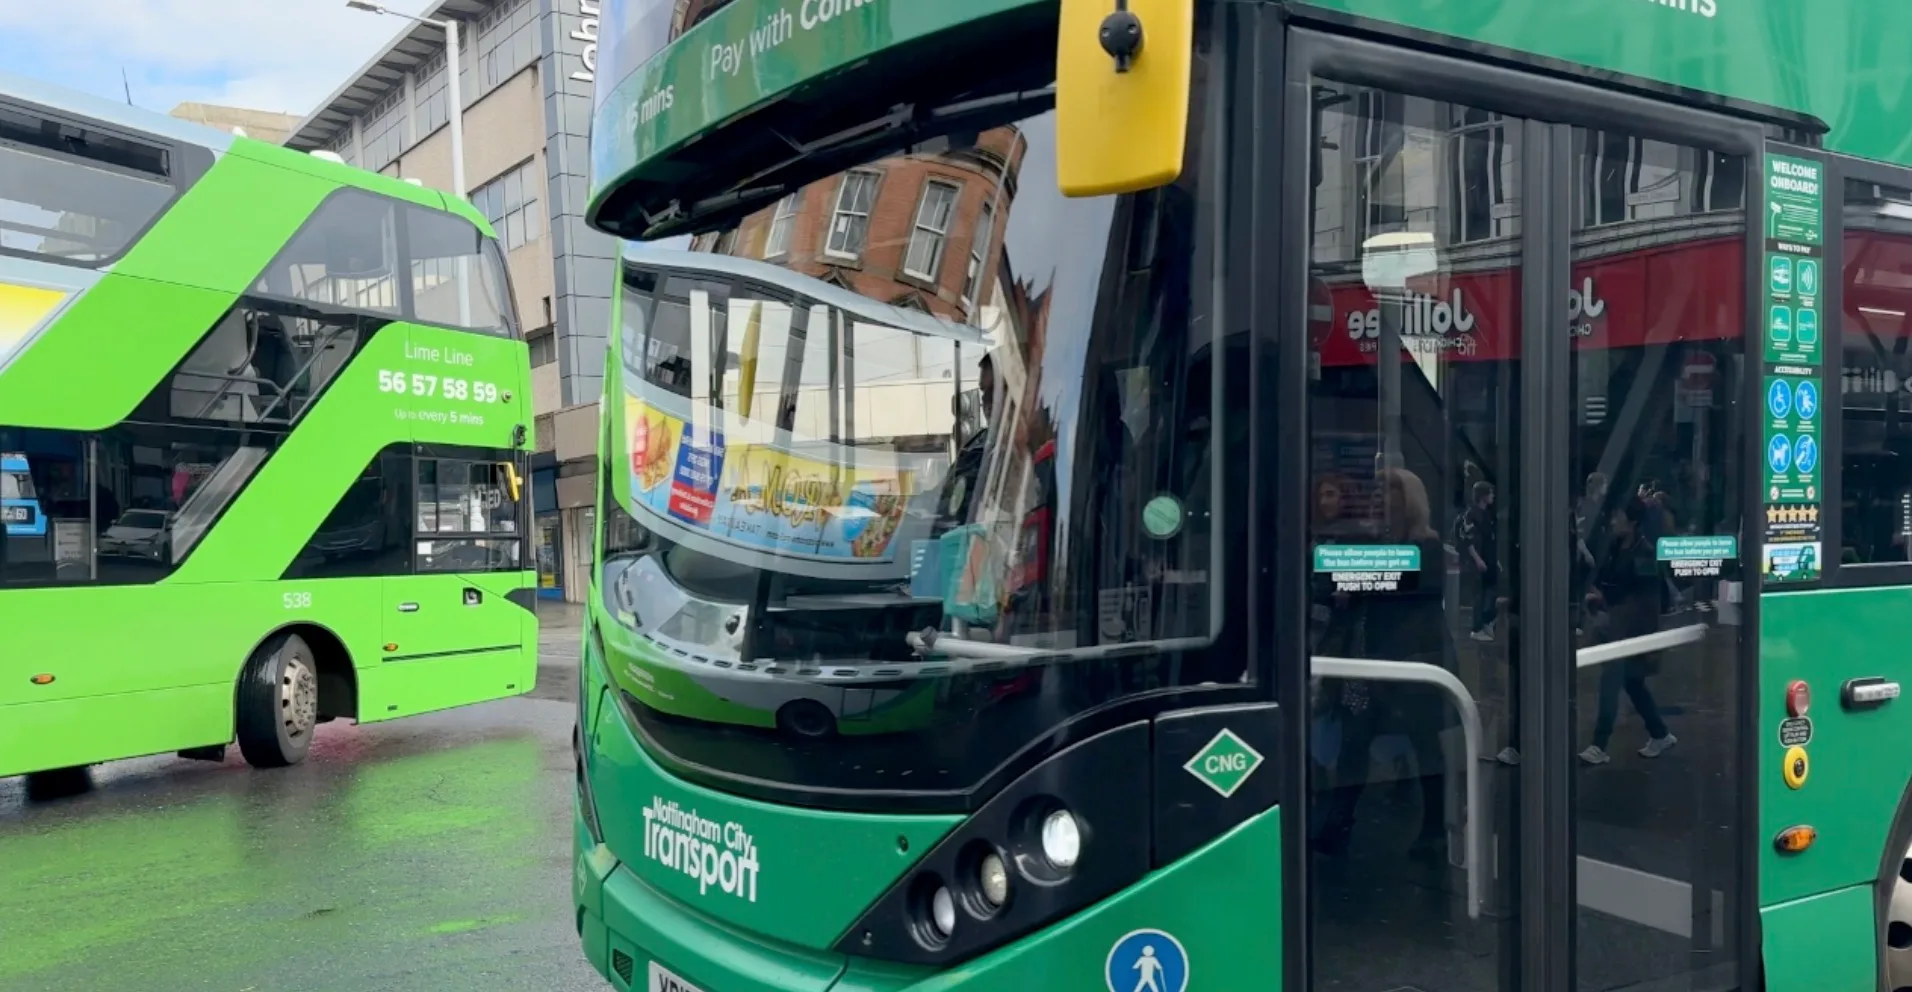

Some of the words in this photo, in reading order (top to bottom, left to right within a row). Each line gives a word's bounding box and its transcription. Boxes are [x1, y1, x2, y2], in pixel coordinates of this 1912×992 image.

[710, 38, 745, 81] Pay
[750, 7, 792, 57] with
[641, 85, 674, 124] mins
[1772, 160, 1817, 180] WELCOME
[1771, 175, 1818, 195] ONBOARD!
[404, 341, 439, 362] Lime
[444, 347, 474, 366] Line
[378, 369, 407, 394] 56
[412, 373, 438, 397] 57
[442, 377, 468, 401] 58
[473, 381, 498, 404] 59
[394, 408, 407, 420] Up
[418, 411, 448, 425] every
[450, 411, 458, 423] 5
[459, 412, 484, 426] mins
[283, 592, 312, 608] 538
[1205, 753, 1246, 774] CNG
[653, 795, 720, 844] Nottingham
[724, 821, 753, 861] City
[643, 806, 759, 902] Transport
